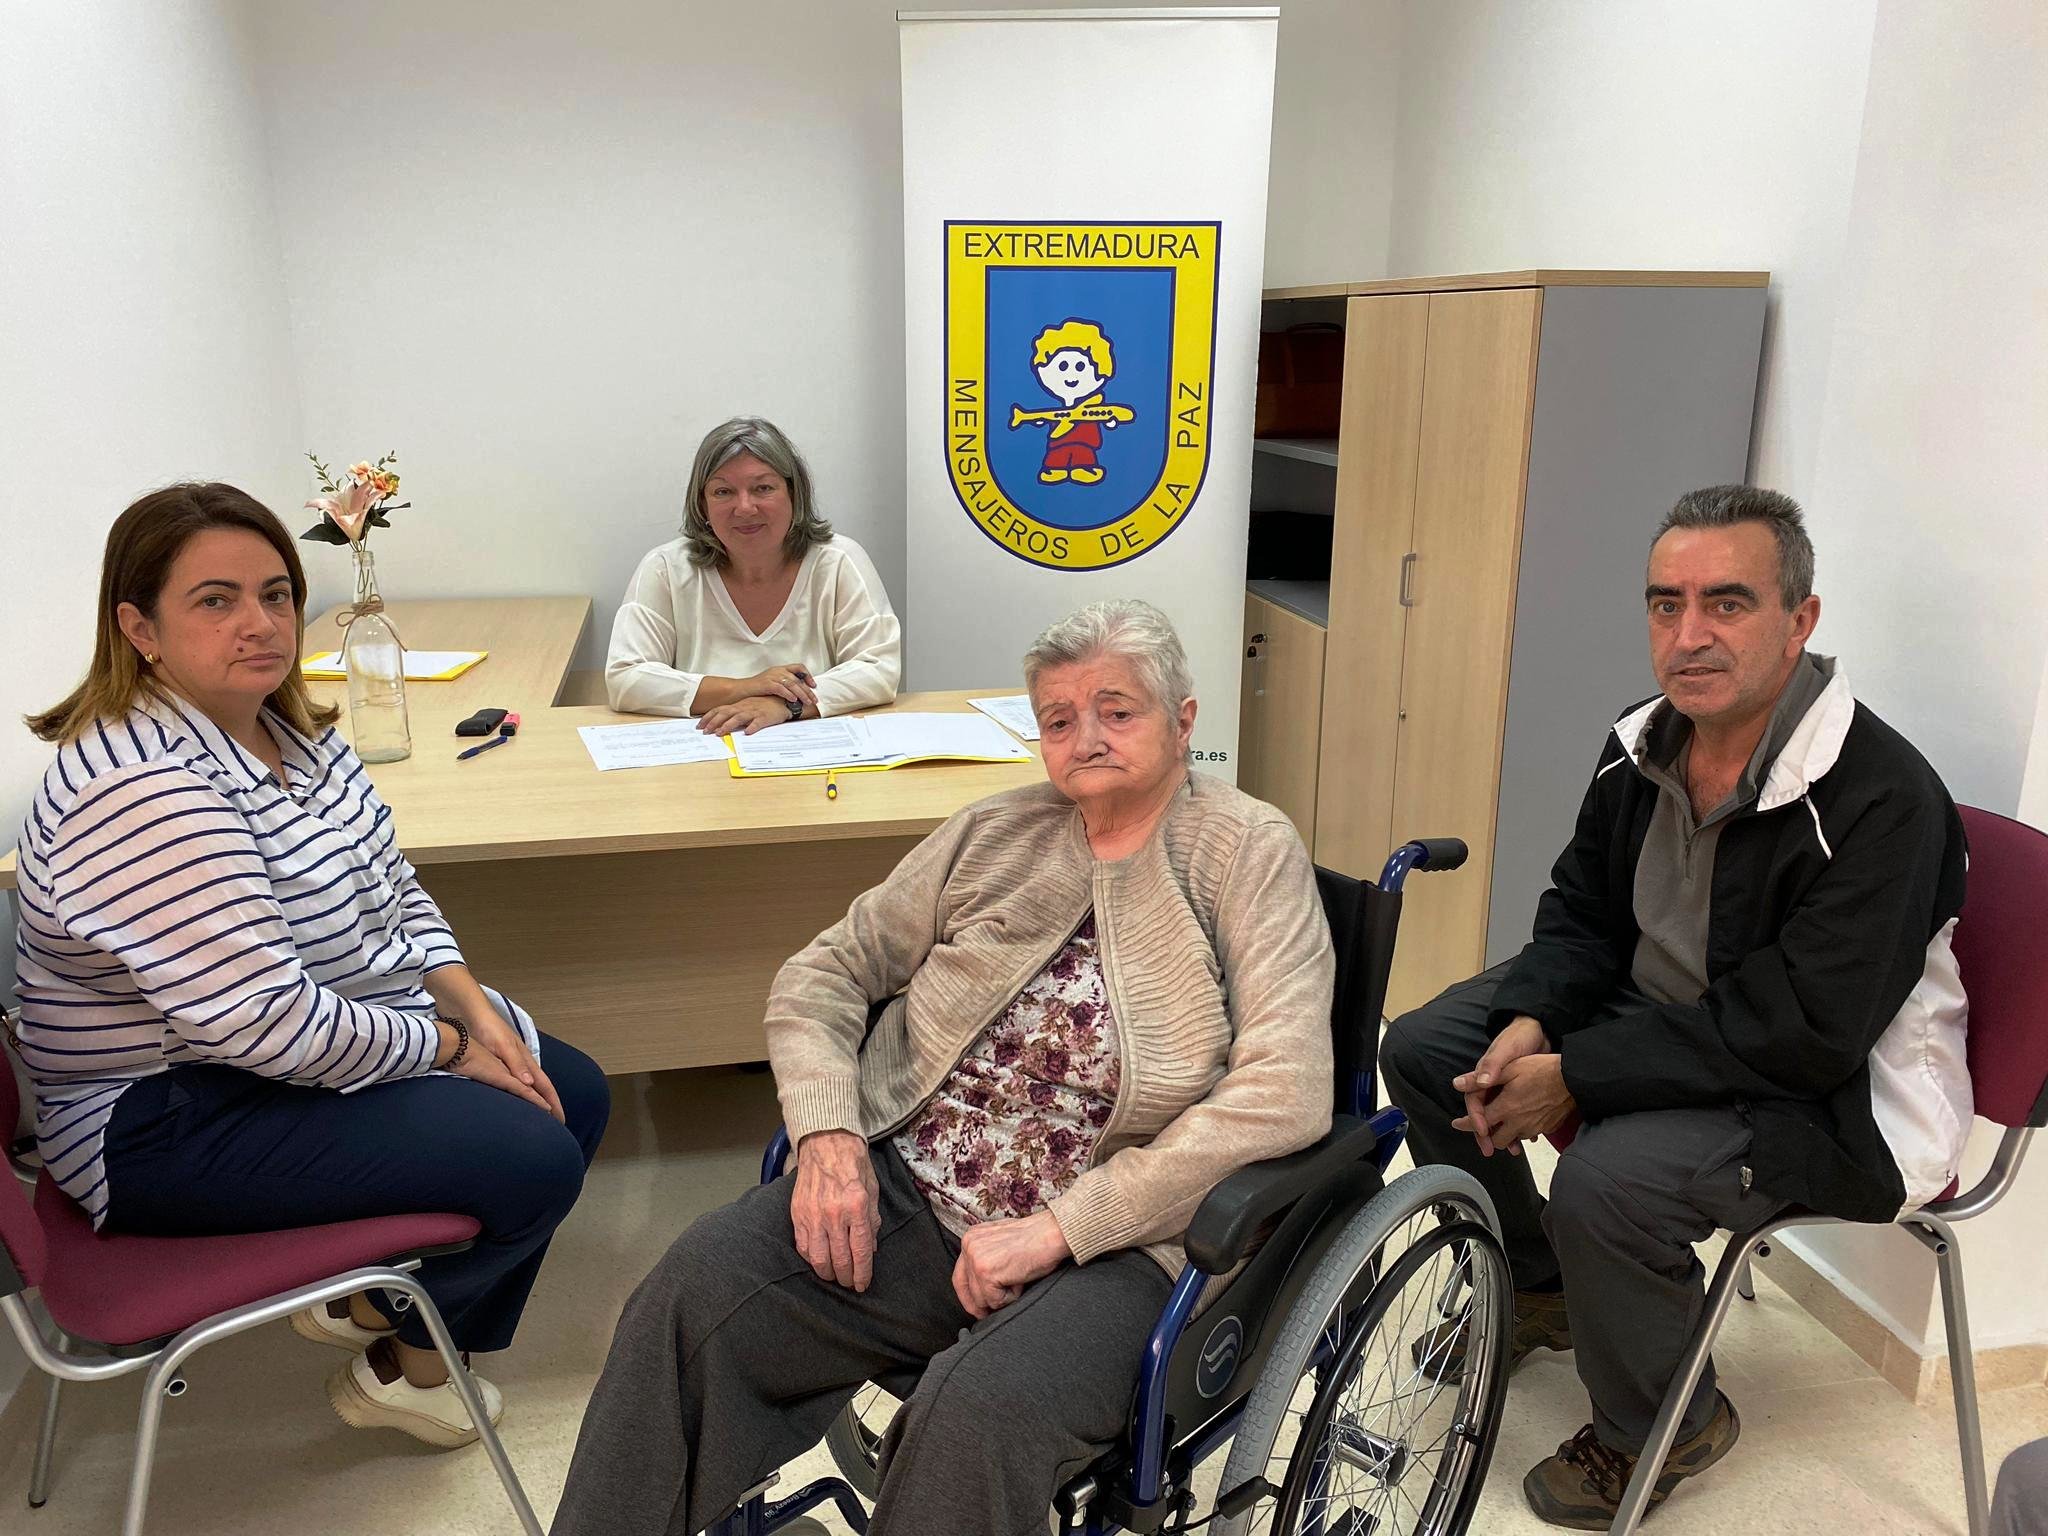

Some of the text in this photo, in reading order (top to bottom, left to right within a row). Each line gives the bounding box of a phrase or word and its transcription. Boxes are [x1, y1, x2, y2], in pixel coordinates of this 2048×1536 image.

[964, 232, 1201, 259] EXTREMADURA
[954, 378, 1203, 560] MENSAJEROS DE LA PAZ
